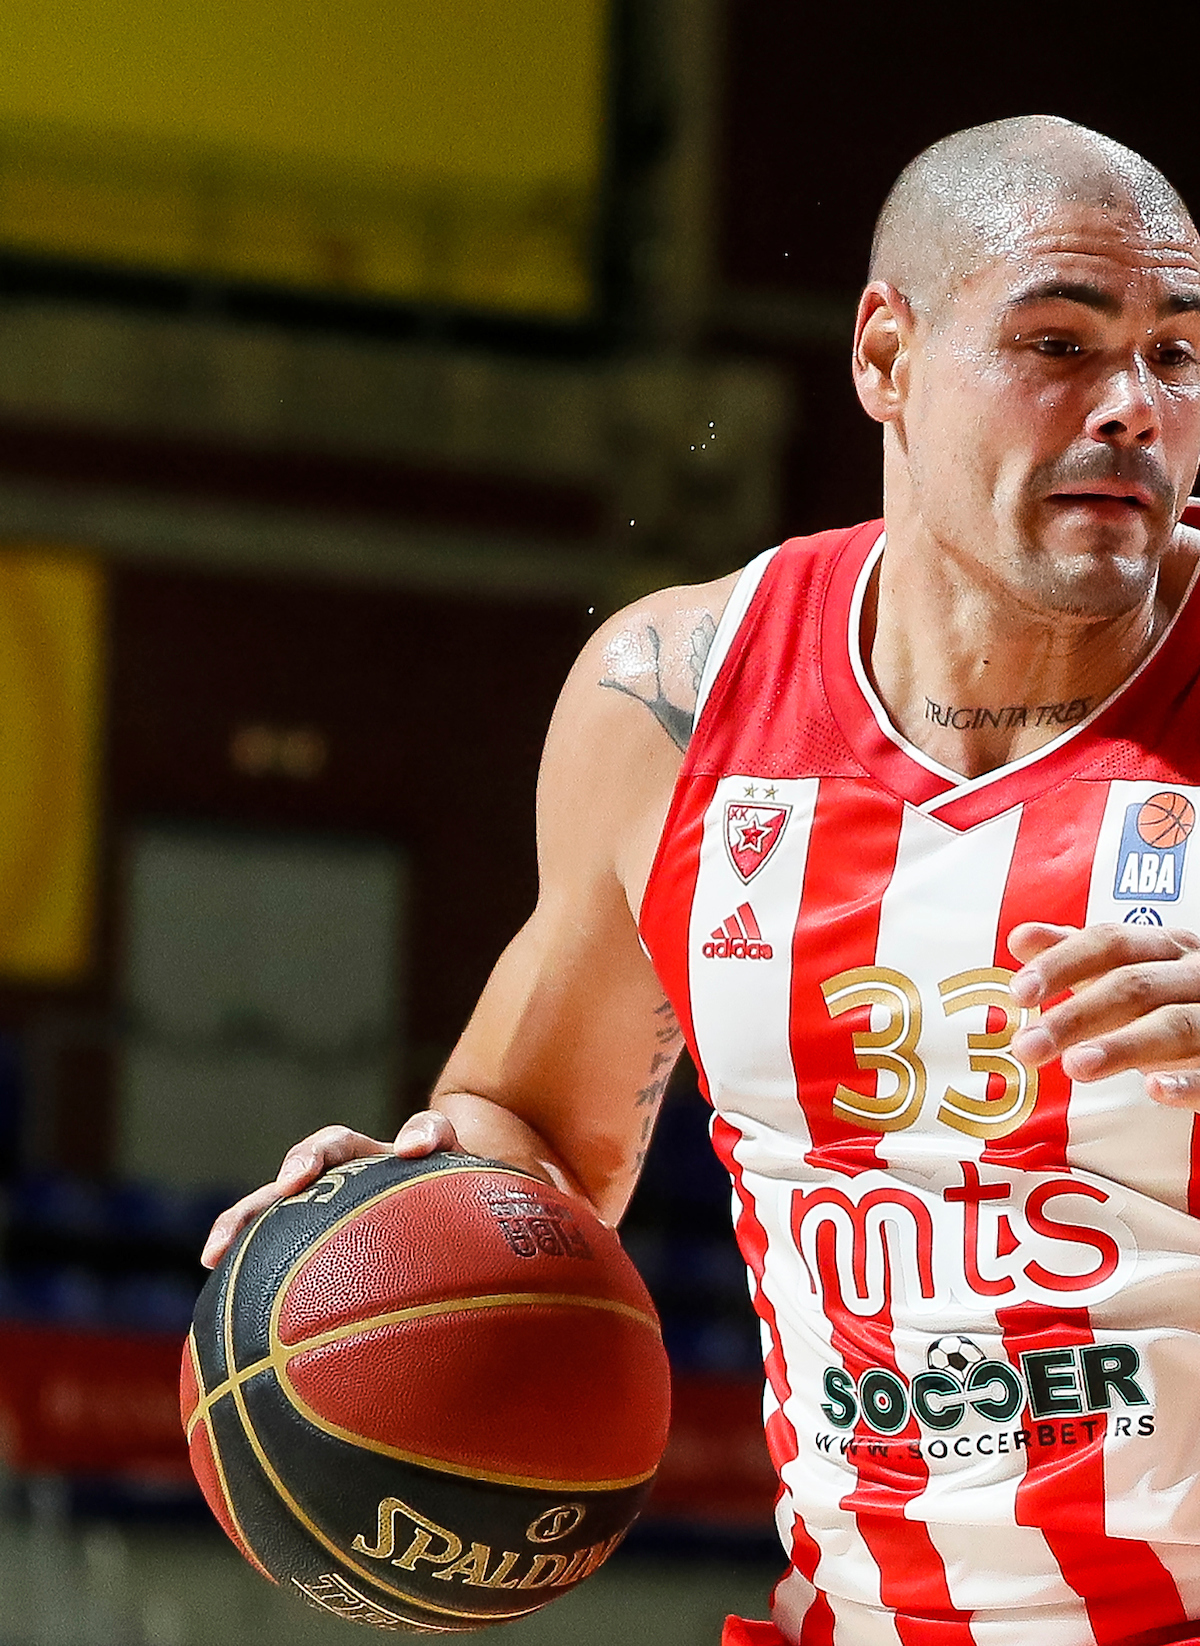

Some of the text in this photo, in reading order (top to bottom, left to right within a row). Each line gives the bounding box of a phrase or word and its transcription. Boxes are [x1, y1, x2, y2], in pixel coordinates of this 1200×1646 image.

[924, 696, 1092, 730] TRIGINTA TRES
[1119, 852, 1176, 894] ABA
[702, 937, 774, 960] adidas
[820, 965, 1042, 1140] 33
[791, 1161, 1121, 1300] mts
[820, 1342, 1151, 1434] SOCCER
[351, 1496, 632, 1590] SPALDIN
